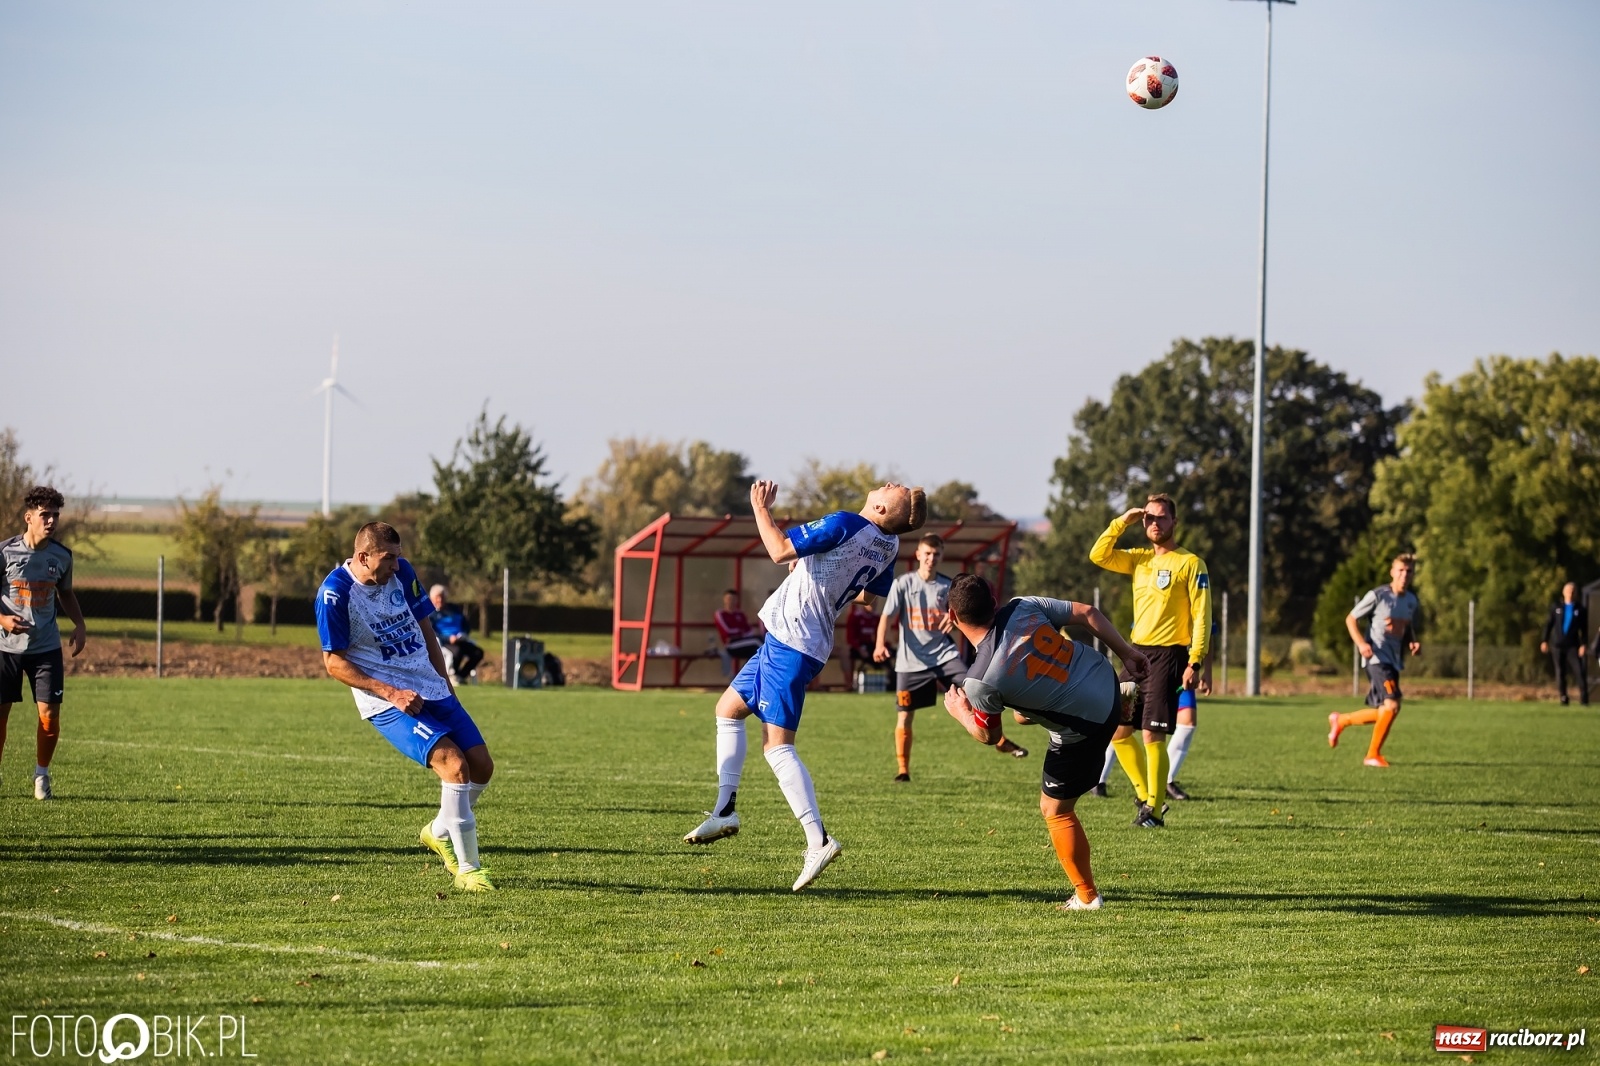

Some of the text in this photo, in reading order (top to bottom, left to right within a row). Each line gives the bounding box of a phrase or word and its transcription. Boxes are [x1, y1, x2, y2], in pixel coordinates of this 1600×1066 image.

[834, 565, 877, 611] 6
[379, 633, 423, 661] PIK
[1025, 623, 1075, 685] 18
[413, 721, 434, 741] 11
